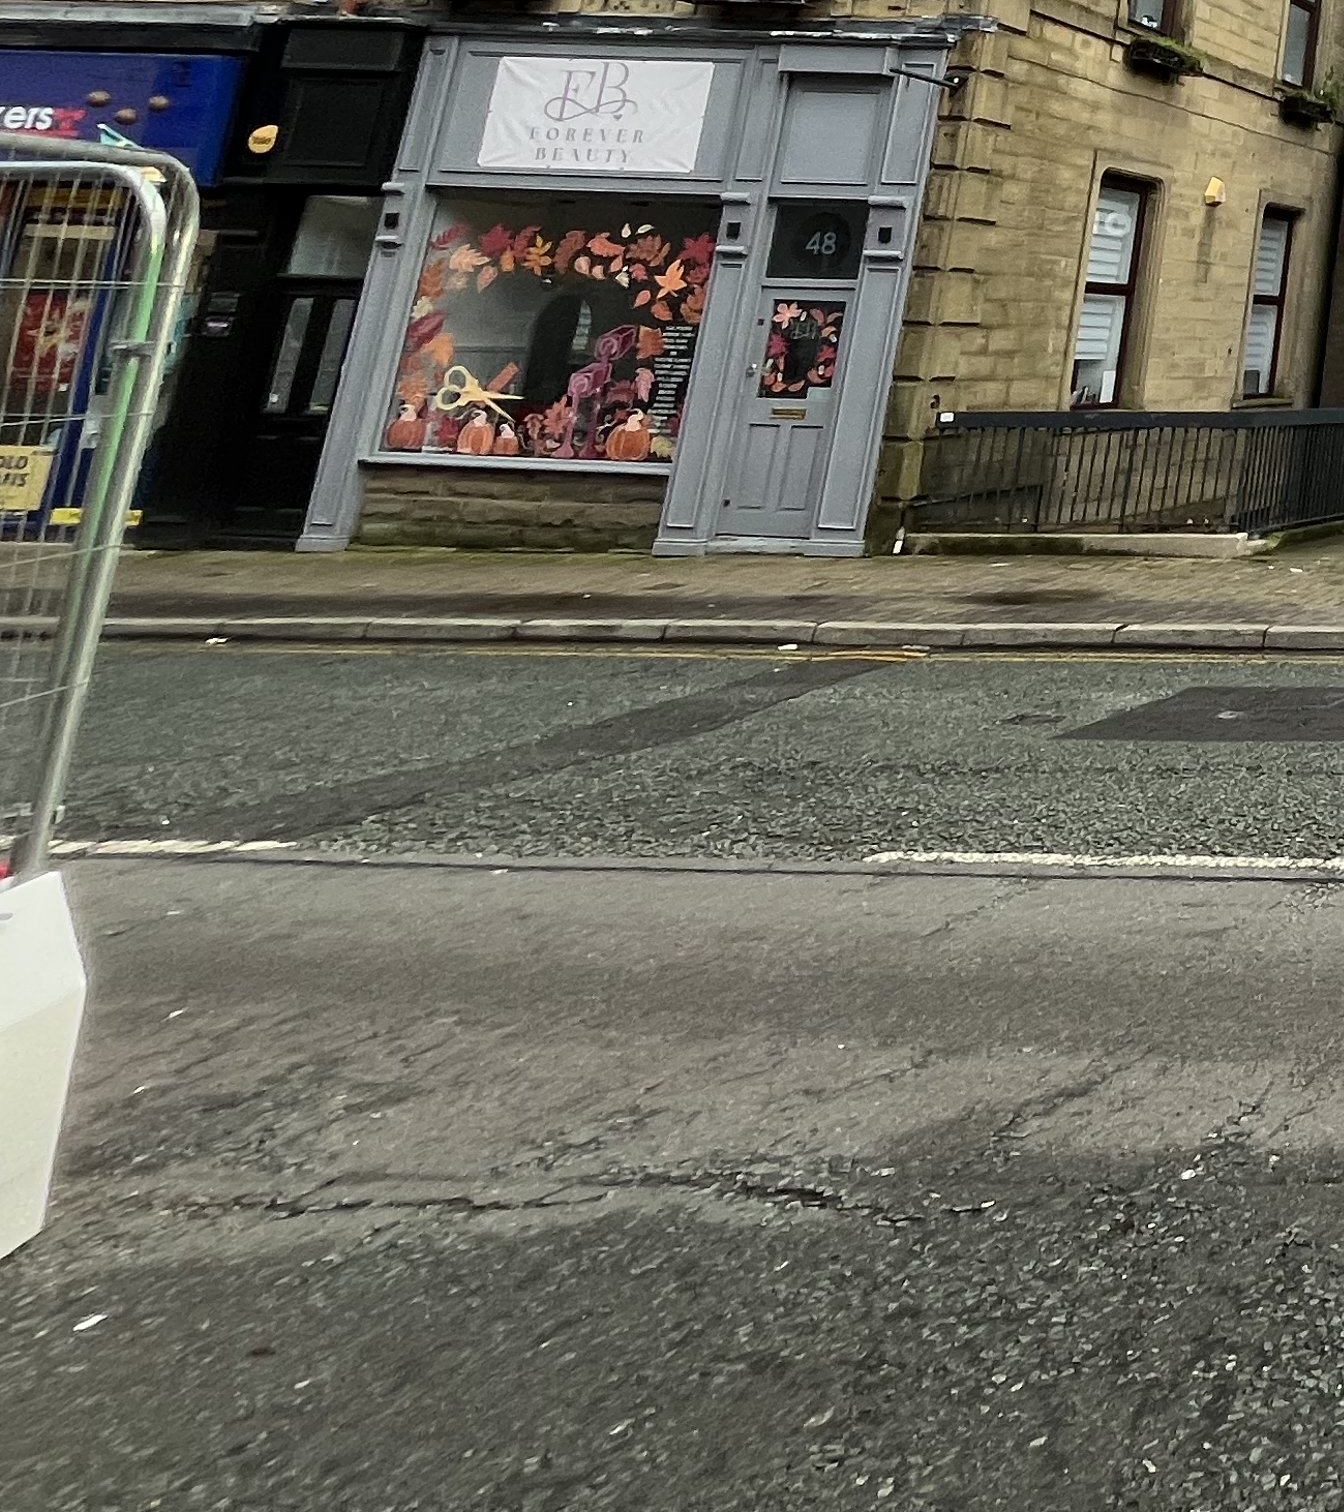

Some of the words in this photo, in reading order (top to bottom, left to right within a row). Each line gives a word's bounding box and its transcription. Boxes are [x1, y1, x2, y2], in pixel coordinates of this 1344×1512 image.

[0, 106, 54, 130] ers
[529, 126, 645, 144] FOREVER
[535, 147, 633, 164] BEAUTY
[805, 231, 837, 256] 48
